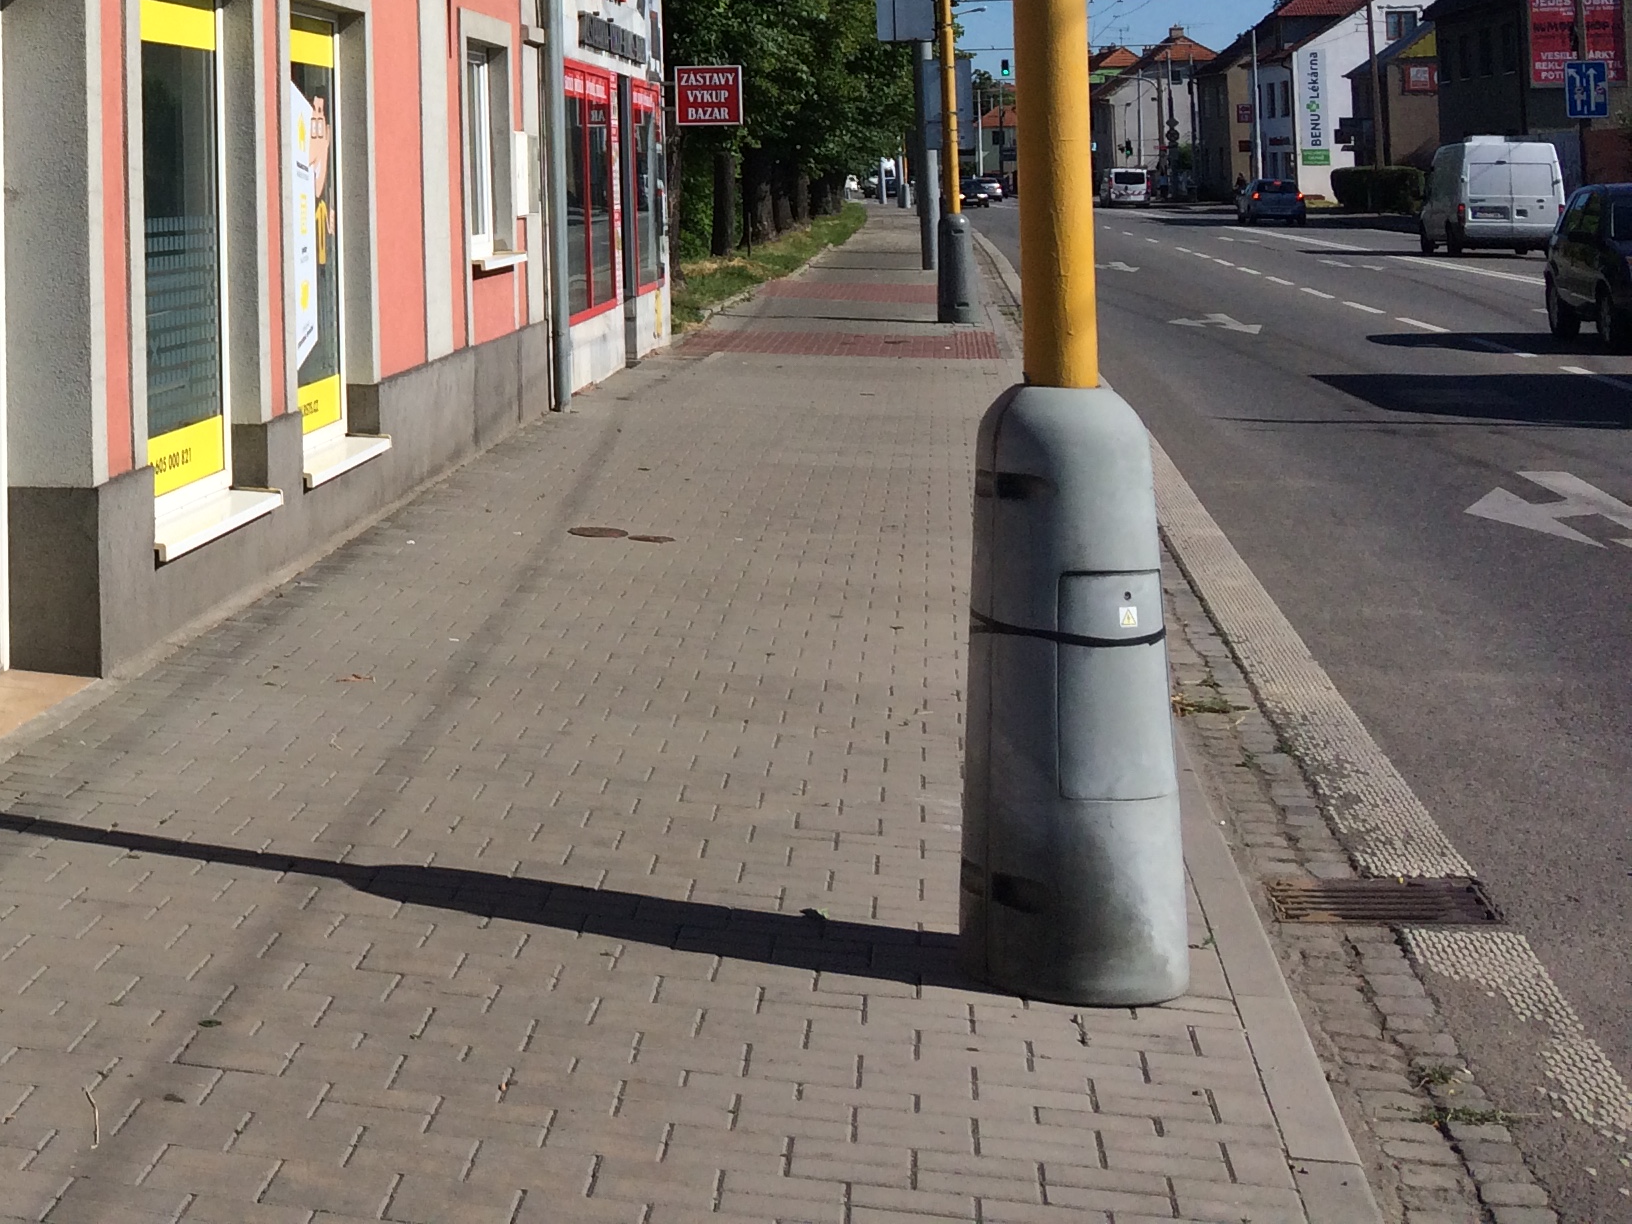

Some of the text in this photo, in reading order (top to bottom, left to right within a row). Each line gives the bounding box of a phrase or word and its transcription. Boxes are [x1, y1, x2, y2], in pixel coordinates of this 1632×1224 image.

[680, 71, 735, 85] ZÁSTAVY
[1308, 52, 1320, 99] Lékárna
[687, 87, 729, 103] VÝKUP
[687, 107, 729, 121] BAZAR
[1310, 113, 1322, 146] BENU
